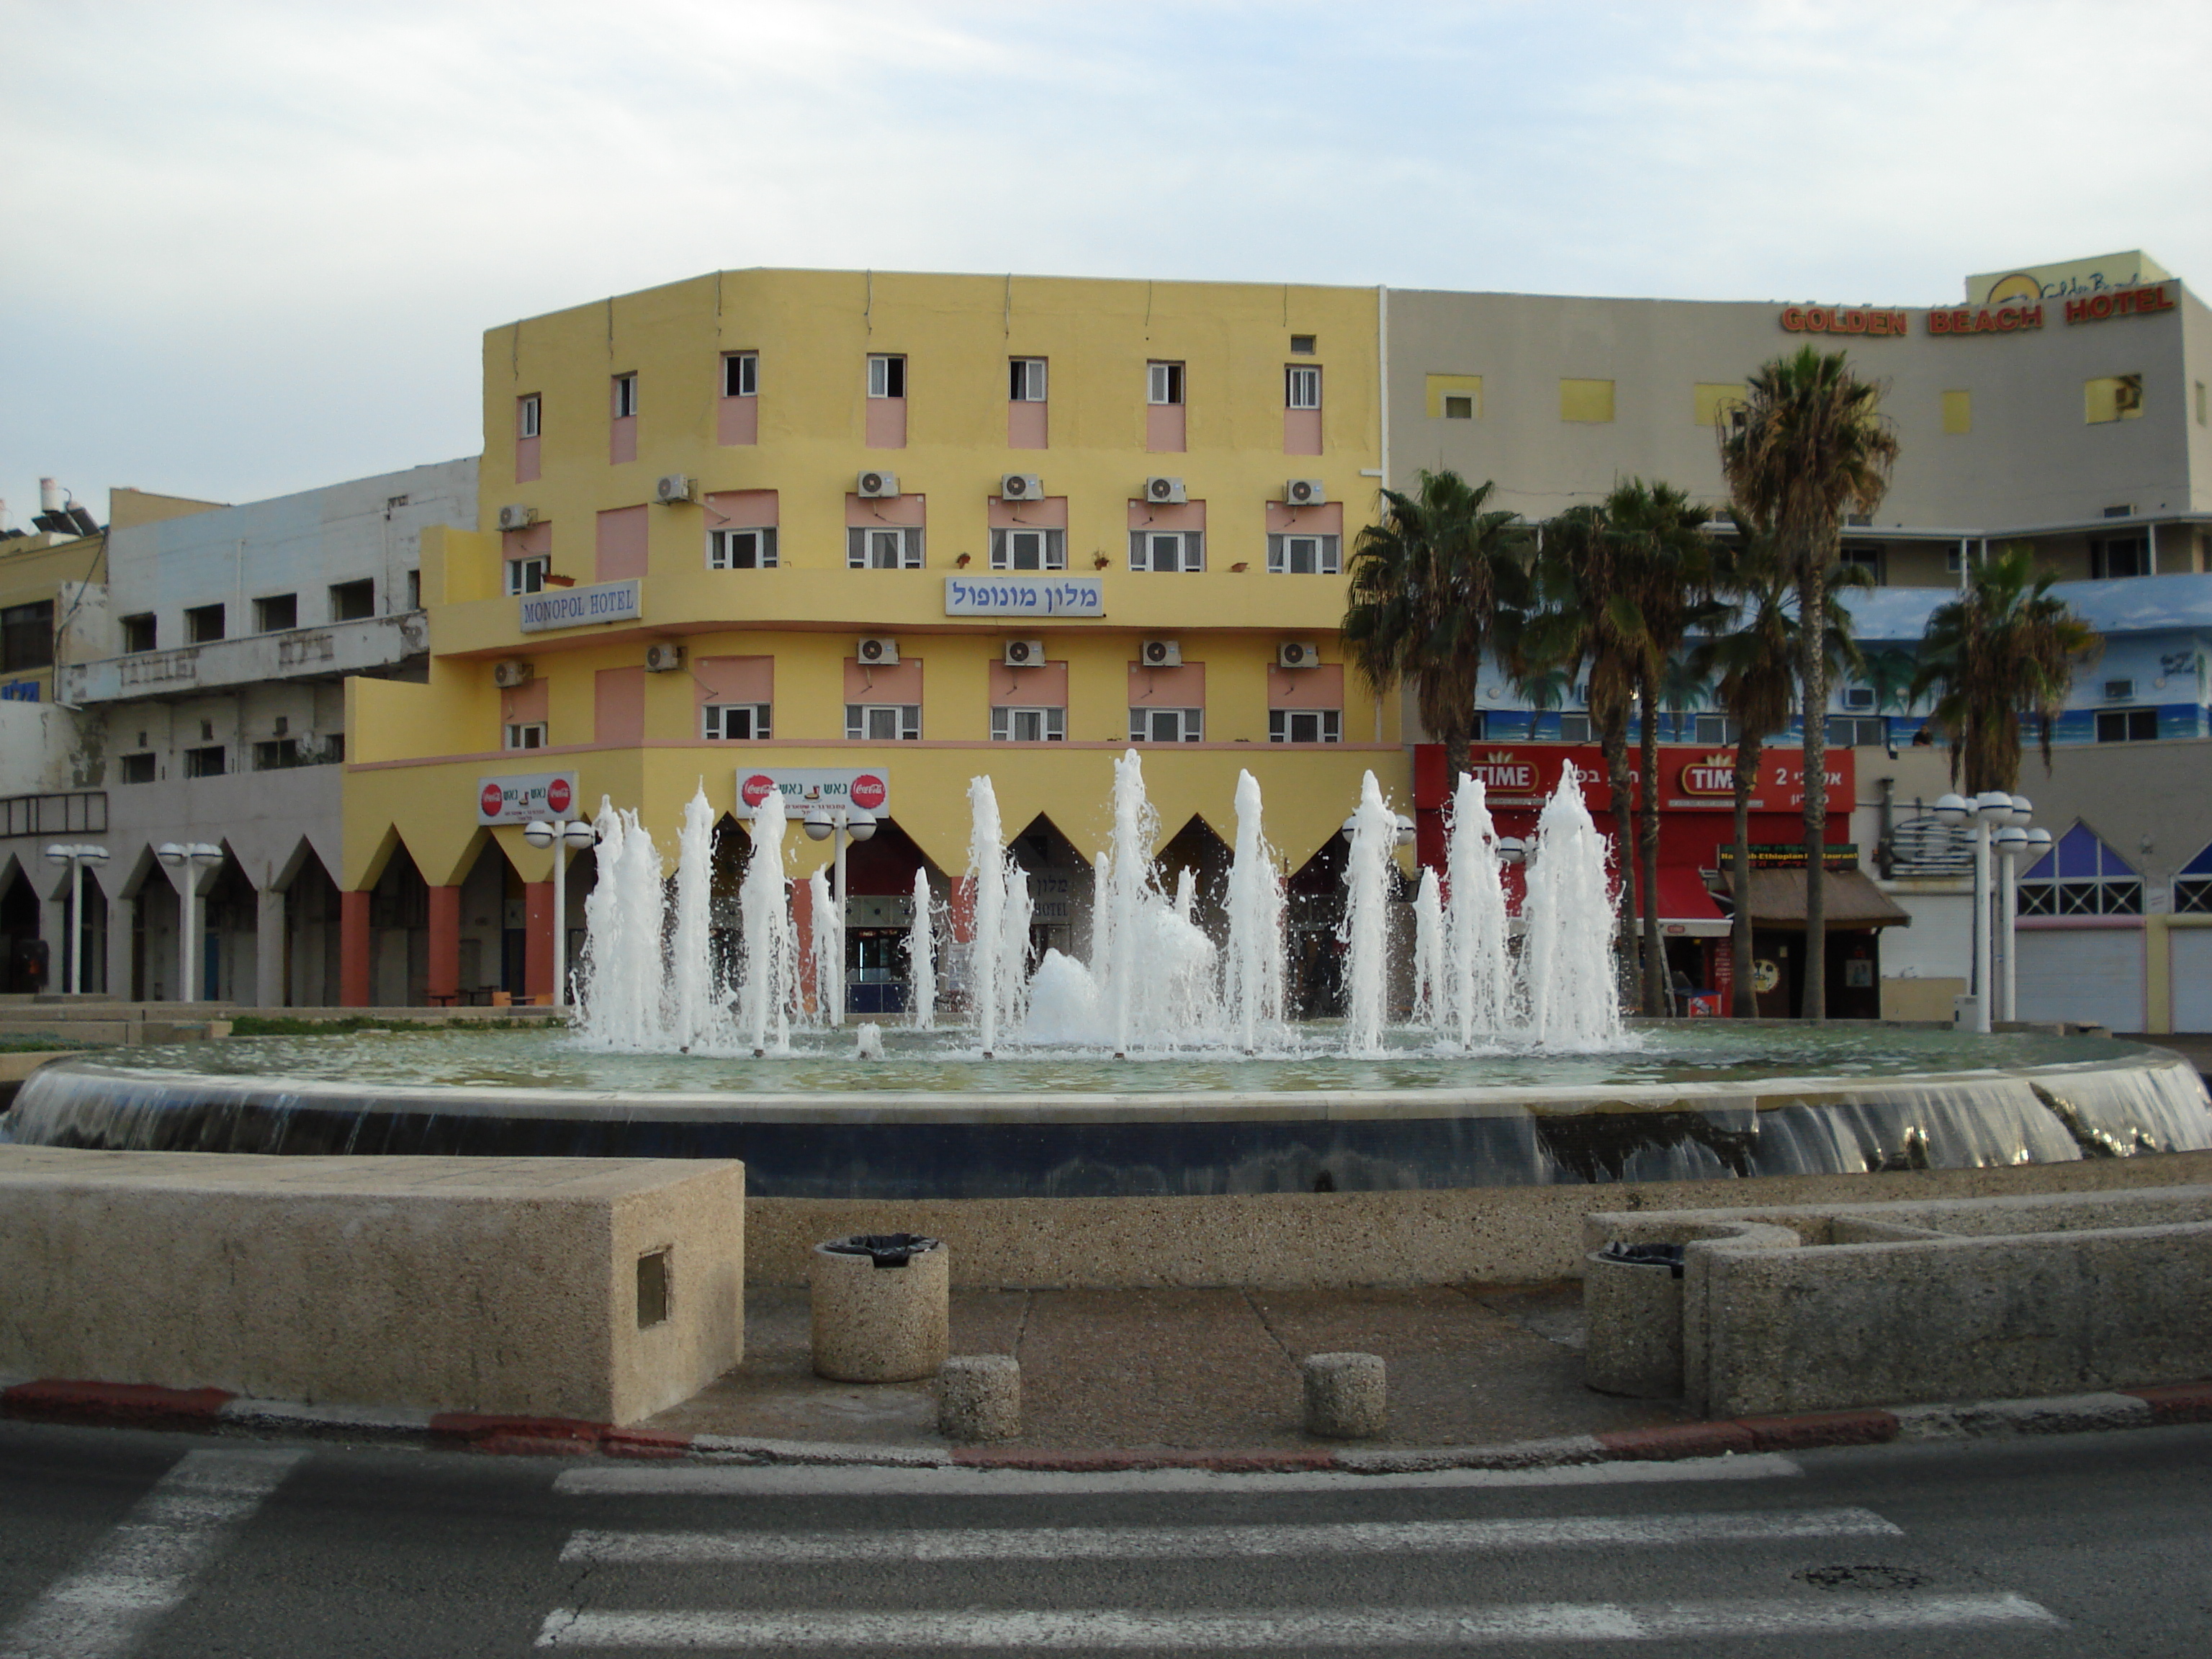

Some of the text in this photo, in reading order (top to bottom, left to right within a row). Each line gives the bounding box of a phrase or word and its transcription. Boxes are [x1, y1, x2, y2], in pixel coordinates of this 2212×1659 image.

[1781, 286, 2175, 336] GOLDEN BEACH HOTEL
[524, 590, 634, 624] MONOPOL HOTEL
[952, 581, 1097, 613] מלון מונופול
[1473, 766, 1530, 786] TIME
[1691, 768, 1735, 789] TIM
[1776, 768, 1787, 786] 2
[1037, 875, 1068, 896] מלון
[1035, 902, 1068, 917] HOTEL
